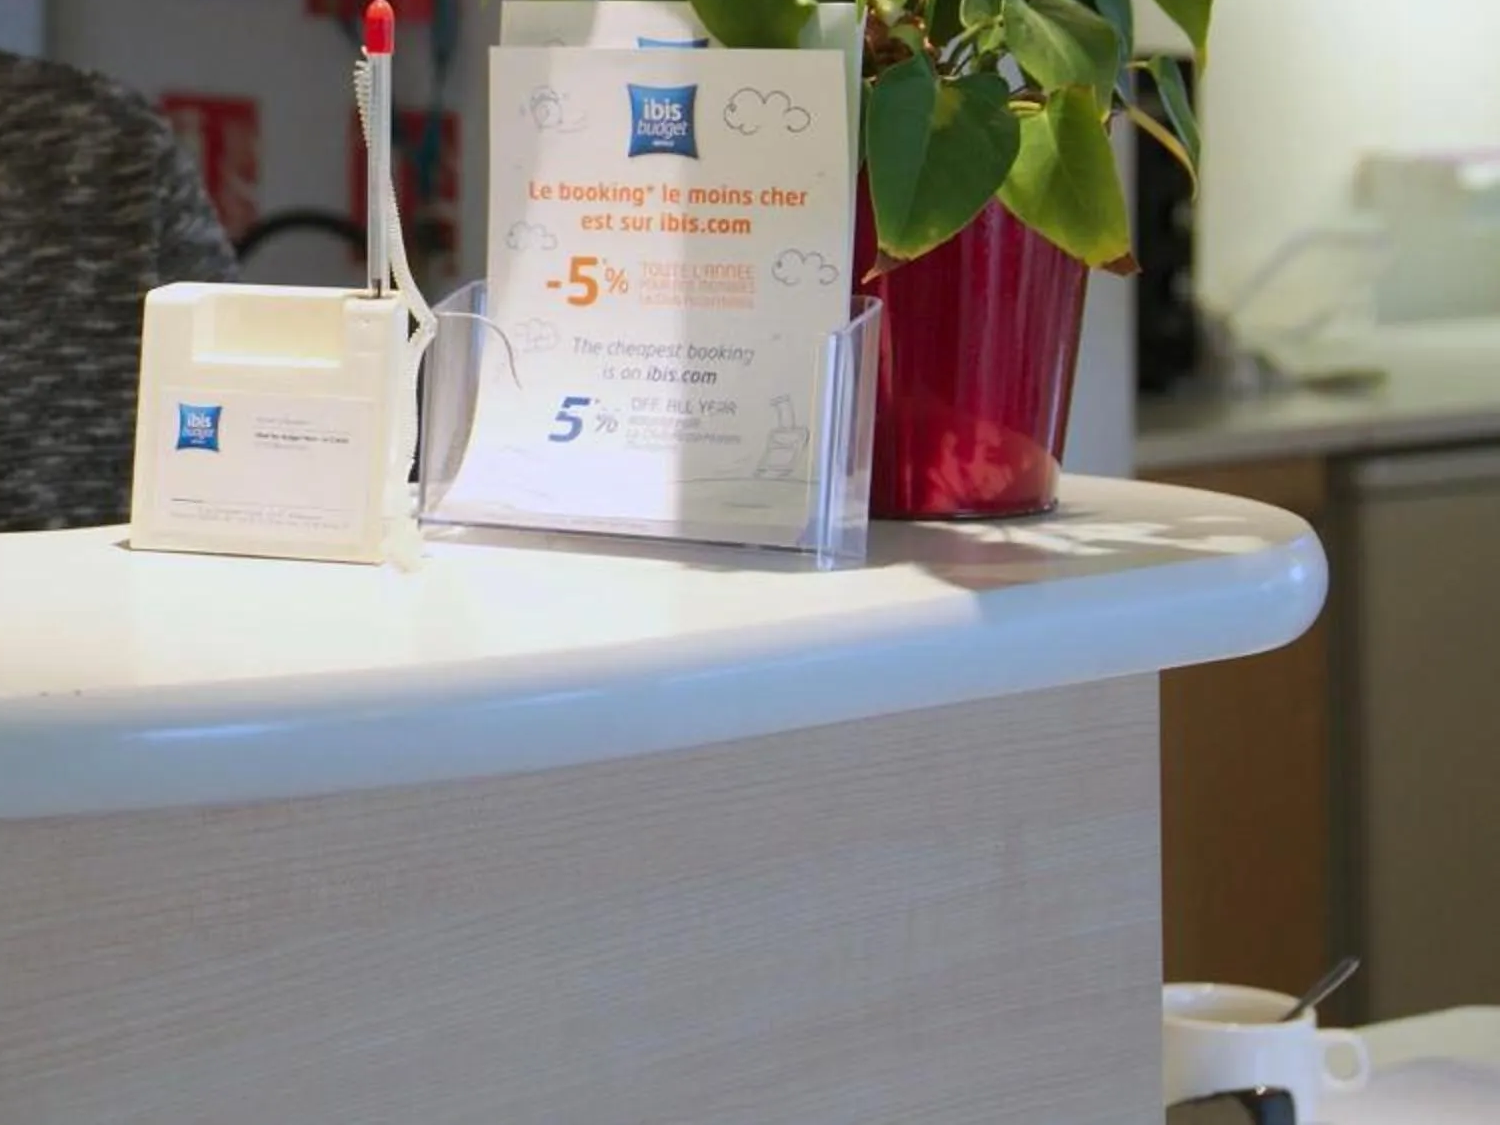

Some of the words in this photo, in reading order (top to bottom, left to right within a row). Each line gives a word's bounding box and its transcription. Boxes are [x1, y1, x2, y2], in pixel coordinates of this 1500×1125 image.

[643, 98, 683, 121] ibis
[637, 119, 688, 140] budget
[528, 181, 552, 200] Le
[663, 184, 681, 203] le
[689, 186, 752, 205] moins
[760, 186, 808, 206] cher
[581, 214, 613, 231] est
[620, 216, 653, 232] sur
[660, 213, 752, 235] ibis.com
[573, 337, 602, 355] The
[607, 340, 682, 362] cheapest
[686, 343, 755, 366] booking
[602, 366, 615, 380] is
[647, 367, 718, 385] ibis.com
[186, 412, 212, 428] ibis
